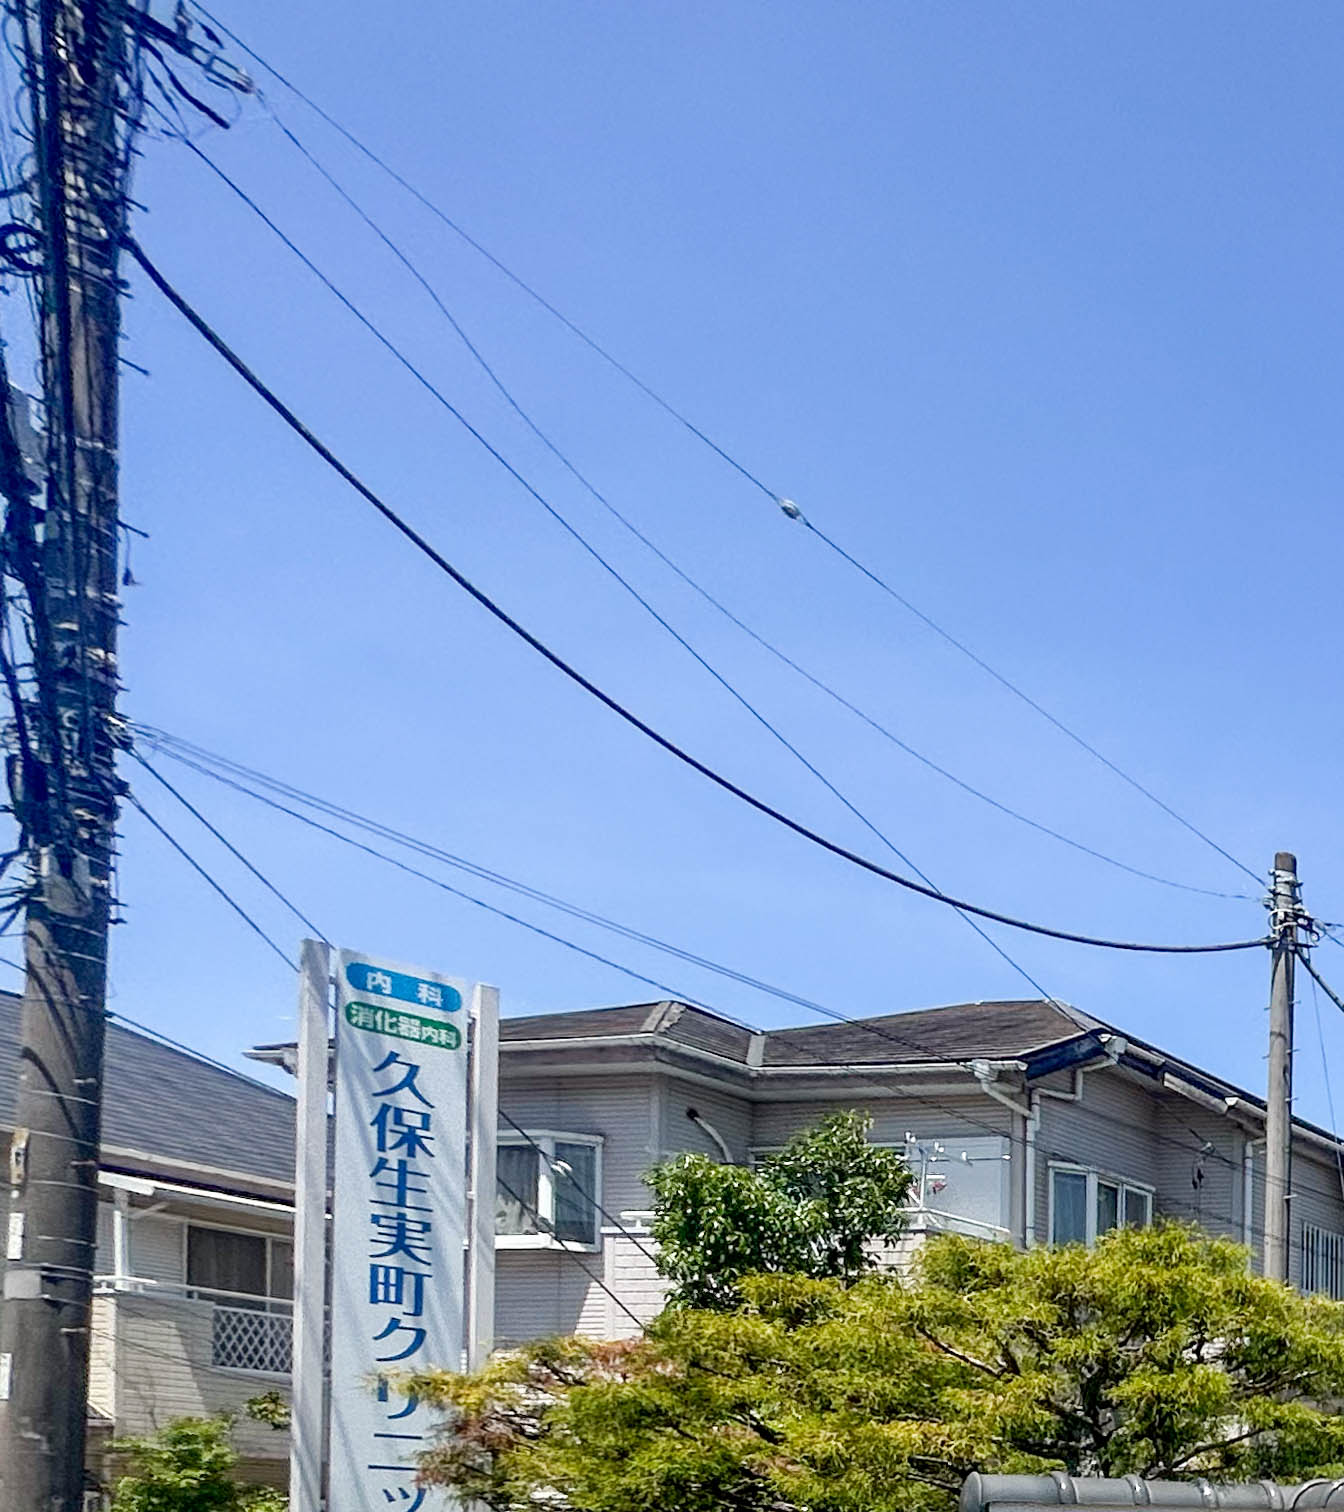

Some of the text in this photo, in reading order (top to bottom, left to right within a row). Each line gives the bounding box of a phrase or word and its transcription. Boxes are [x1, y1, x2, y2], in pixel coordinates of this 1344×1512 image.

[366, 972, 443, 1008] 内科
[350, 1003, 458, 1048] 消化器内科
